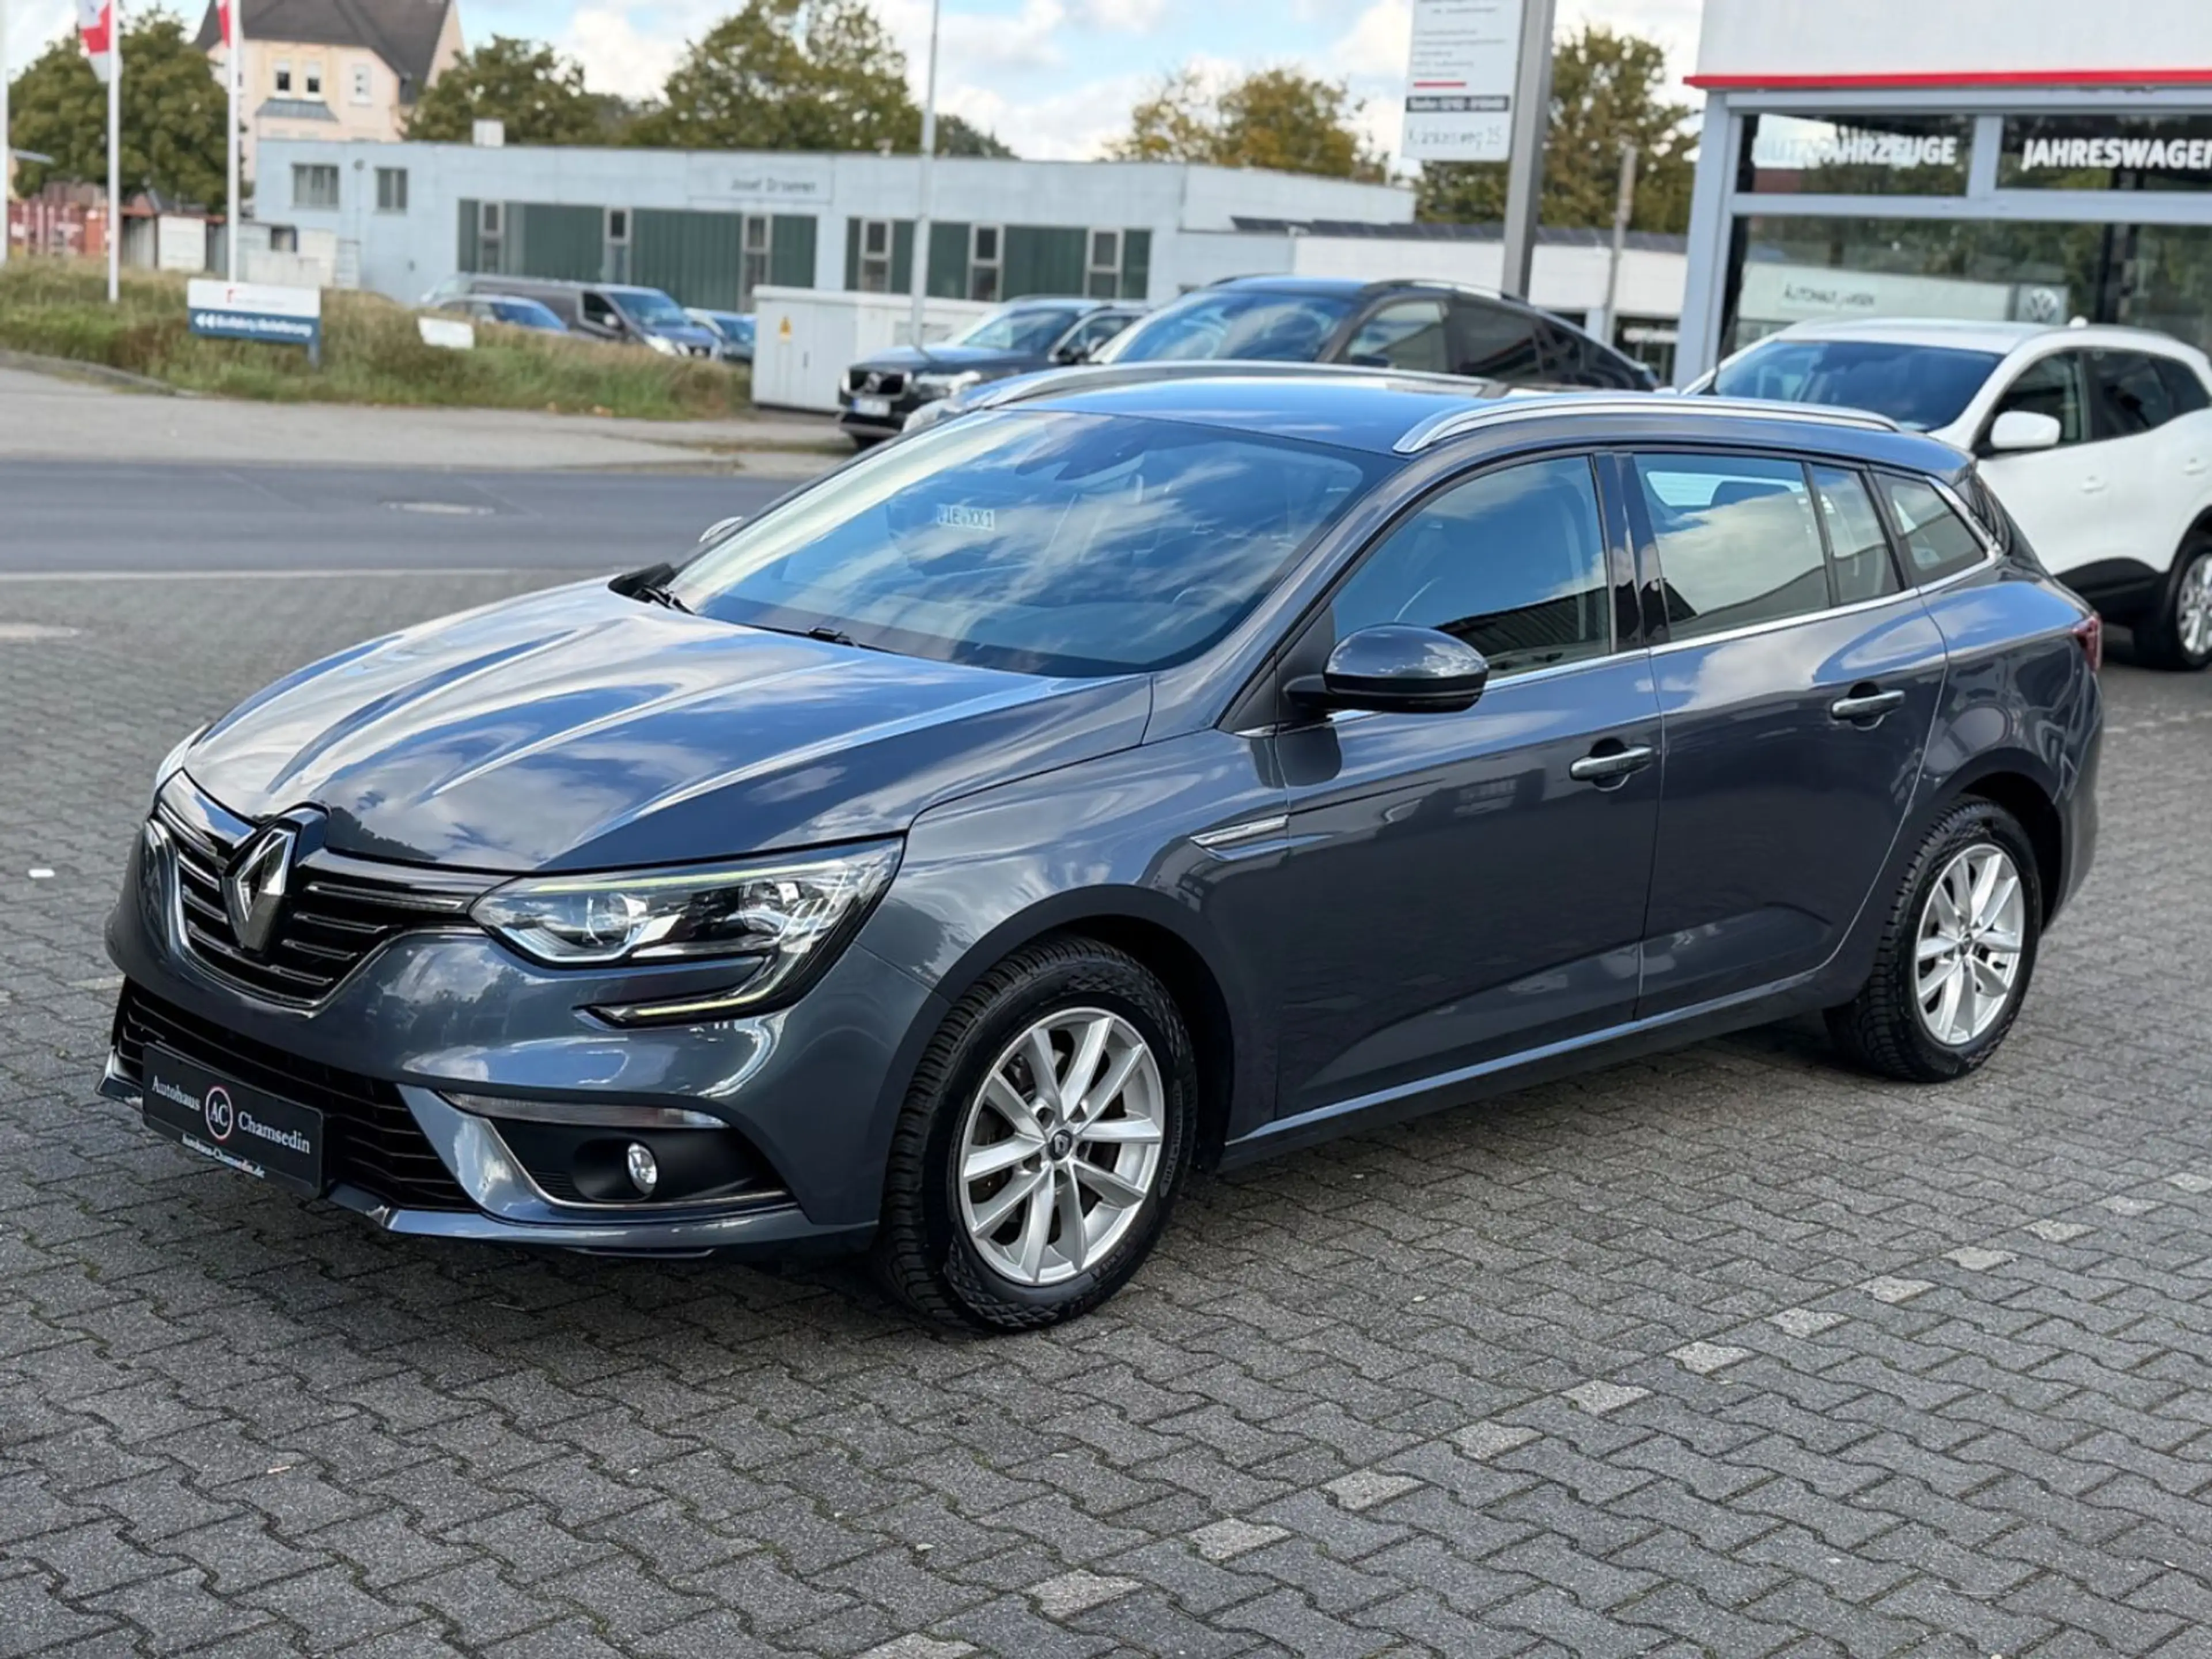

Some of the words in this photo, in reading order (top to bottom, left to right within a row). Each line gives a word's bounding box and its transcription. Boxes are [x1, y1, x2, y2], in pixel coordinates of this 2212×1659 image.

[152, 1074, 200, 1111] Autohaus
[210, 1101, 228, 1127] AC
[238, 1111, 310, 1154] Chamsedin
